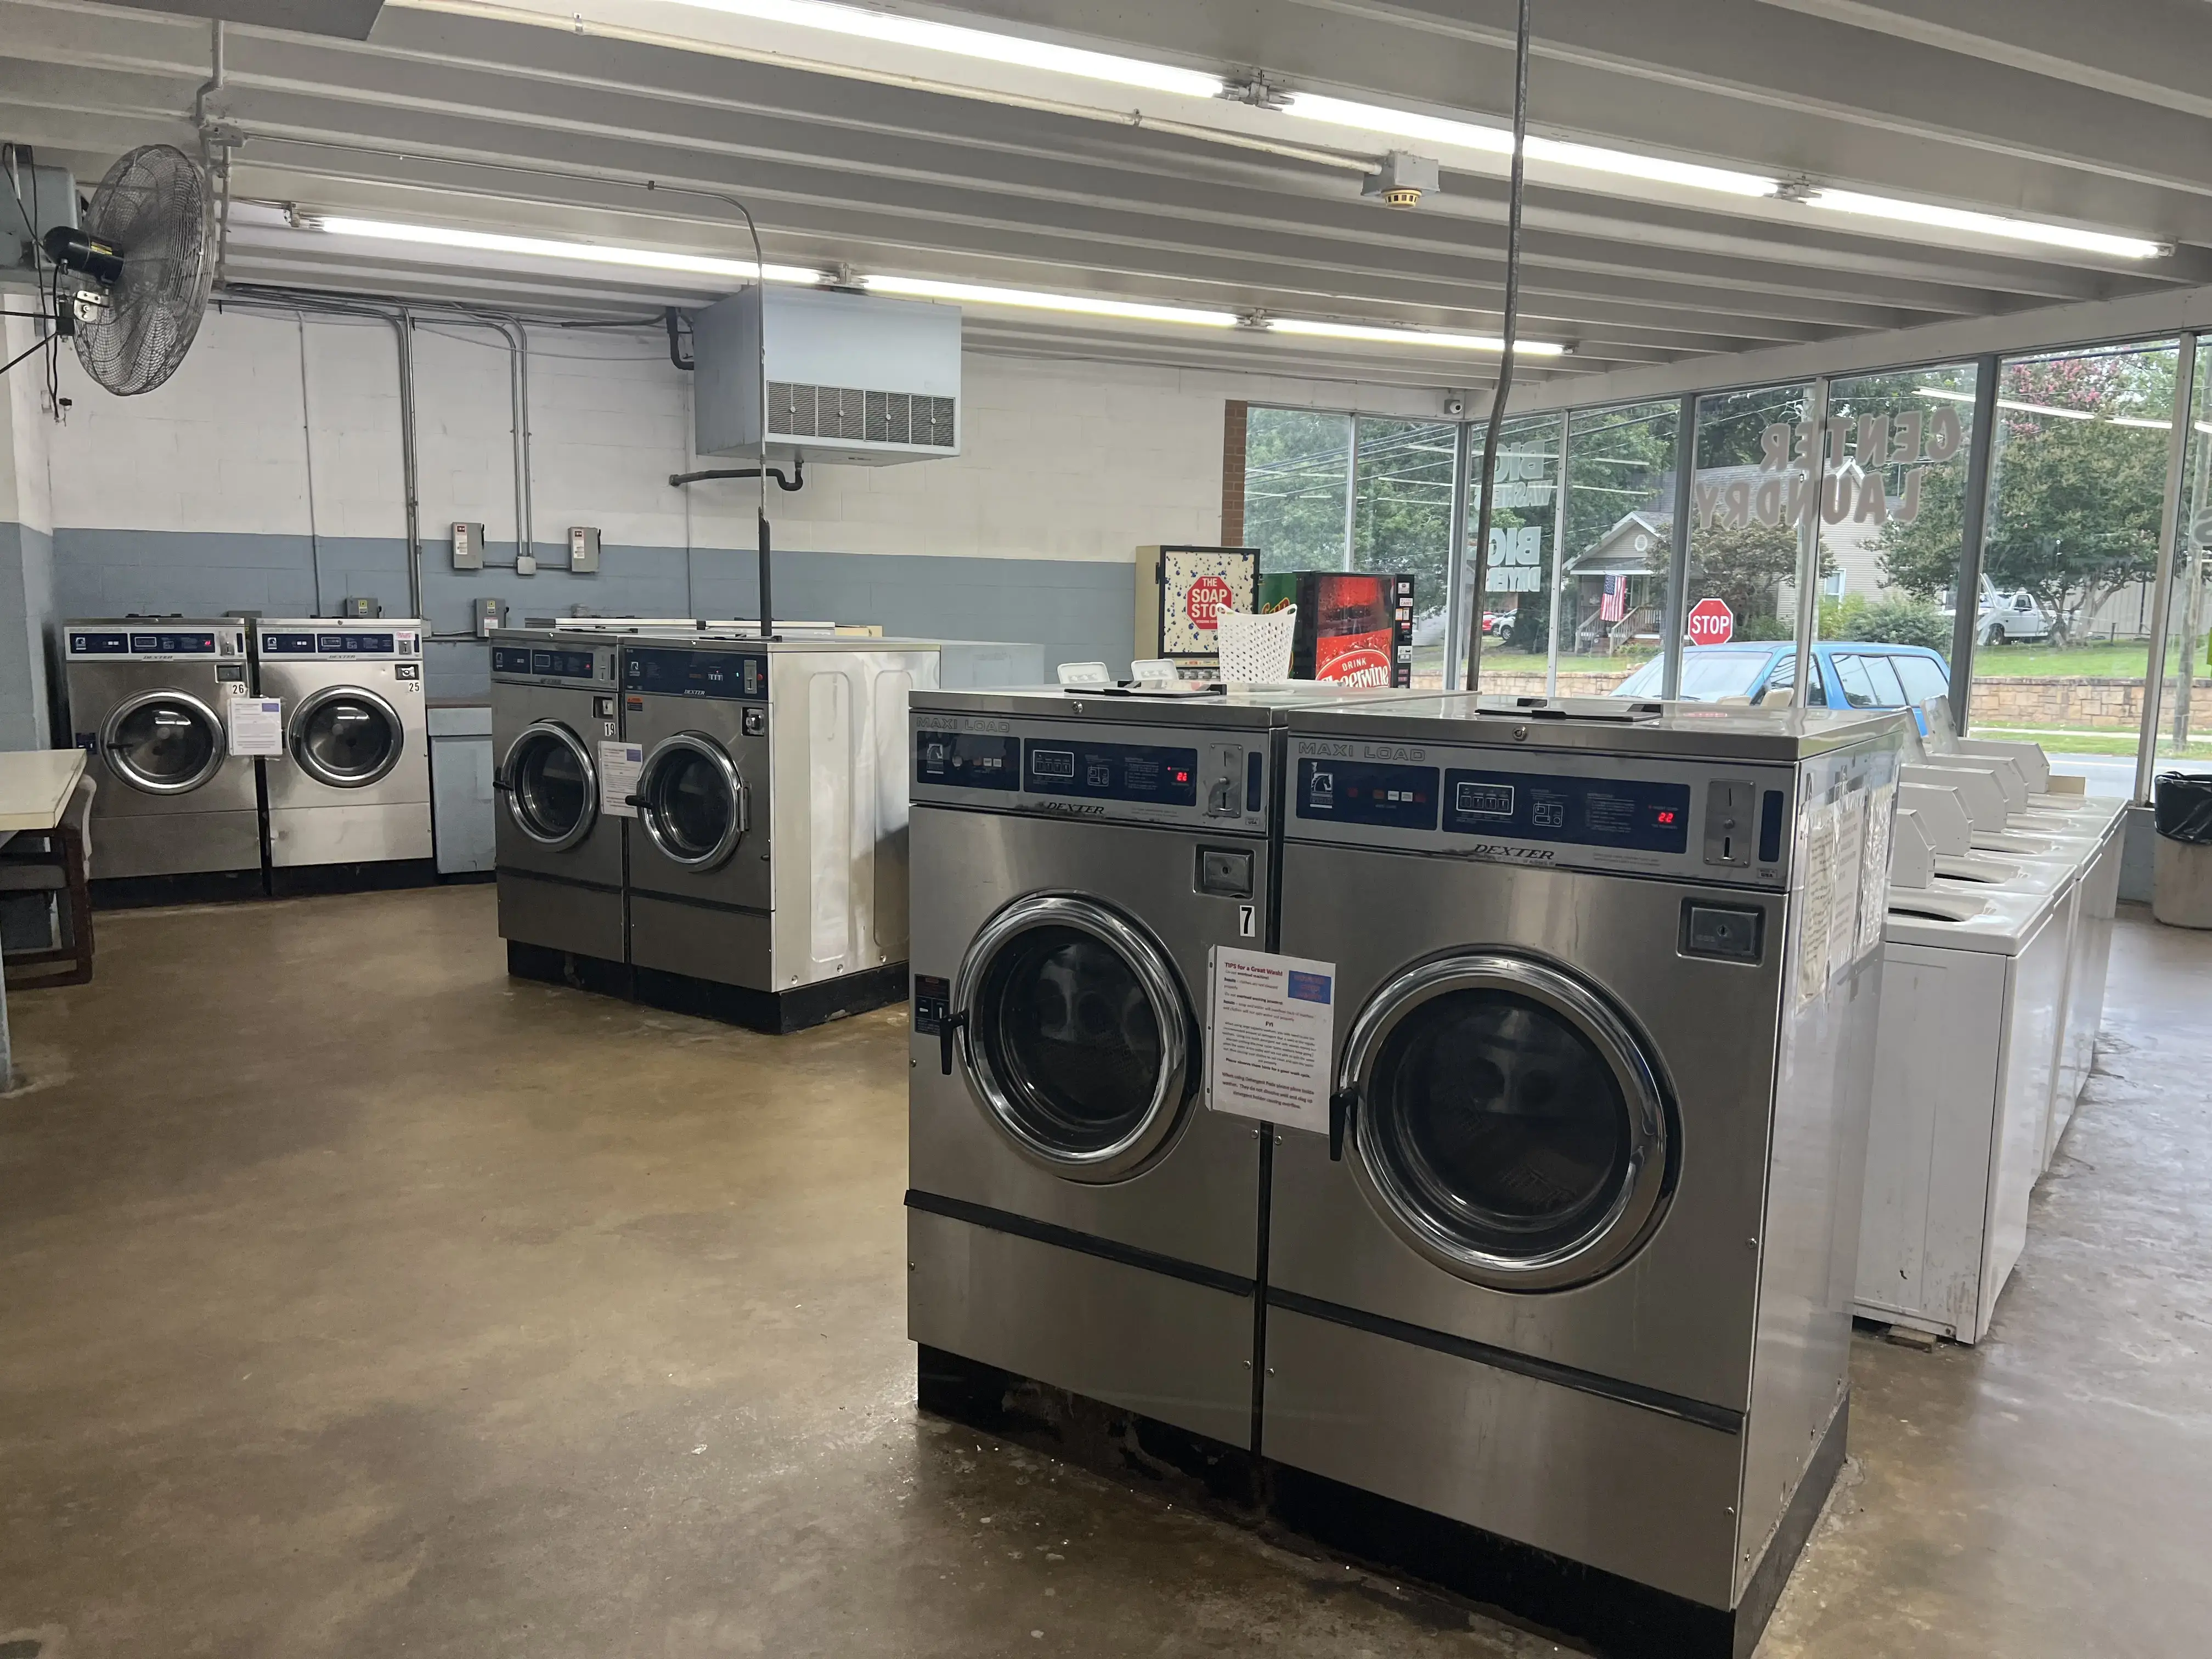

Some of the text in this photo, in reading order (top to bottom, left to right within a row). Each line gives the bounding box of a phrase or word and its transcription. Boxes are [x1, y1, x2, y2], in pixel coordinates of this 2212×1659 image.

[1202, 578, 1217, 587] THE
[1191, 588, 1227, 603] SOAP
[1191, 603, 1226, 618] STO
[1691, 615, 1730, 635] STOP
[1341, 657, 1367, 672] DRINK
[233, 685, 244, 695] 26
[409, 682, 420, 692] 25
[605, 723, 615, 736] 19
[916, 716, 1010, 733] MAXI LOAD
[1299, 742, 1426, 761] MAXI LOAD
[1046, 802, 1105, 815] DEXTER
[1658, 811, 1674, 823] 22
[1474, 844, 1554, 860] DEXTER
[1241, 907, 1252, 934] 7
